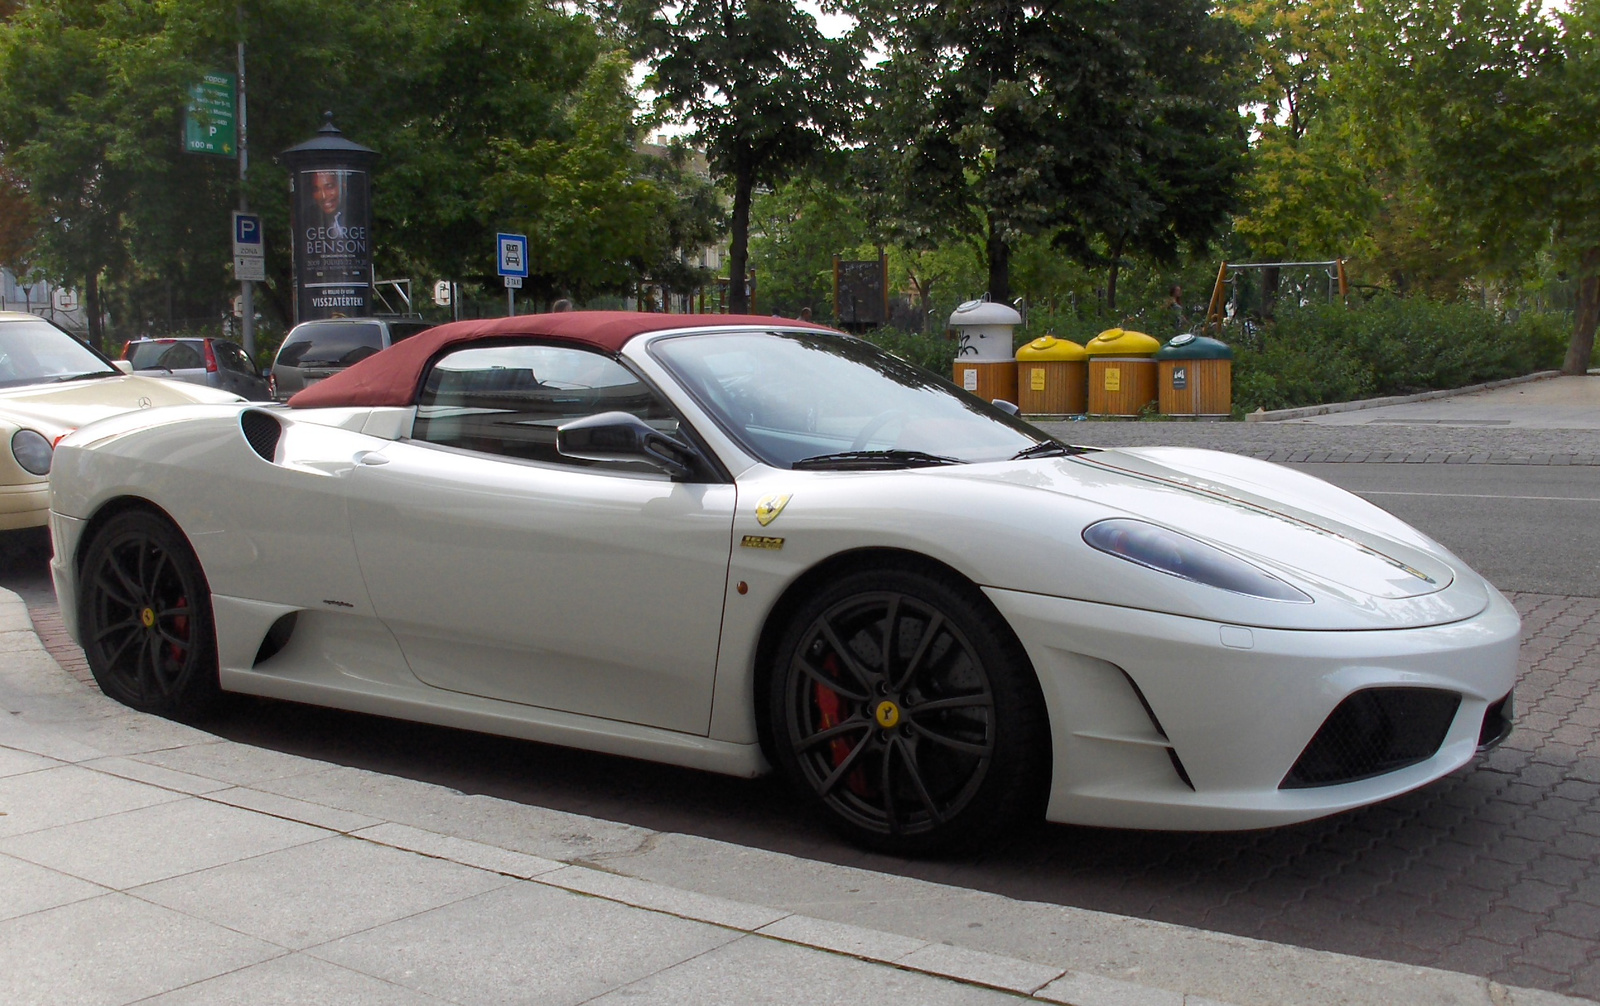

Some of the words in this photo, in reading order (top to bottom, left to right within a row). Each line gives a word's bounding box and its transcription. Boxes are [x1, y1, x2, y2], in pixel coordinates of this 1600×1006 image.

[209, 125, 217, 137] P
[190, 140, 205, 149] 100
[241, 220, 255, 239] P
[306, 226, 365, 241] GEORGE
[306, 239, 366, 254] BENSON
[312, 294, 364, 307] VISSZATÉRTEK!
